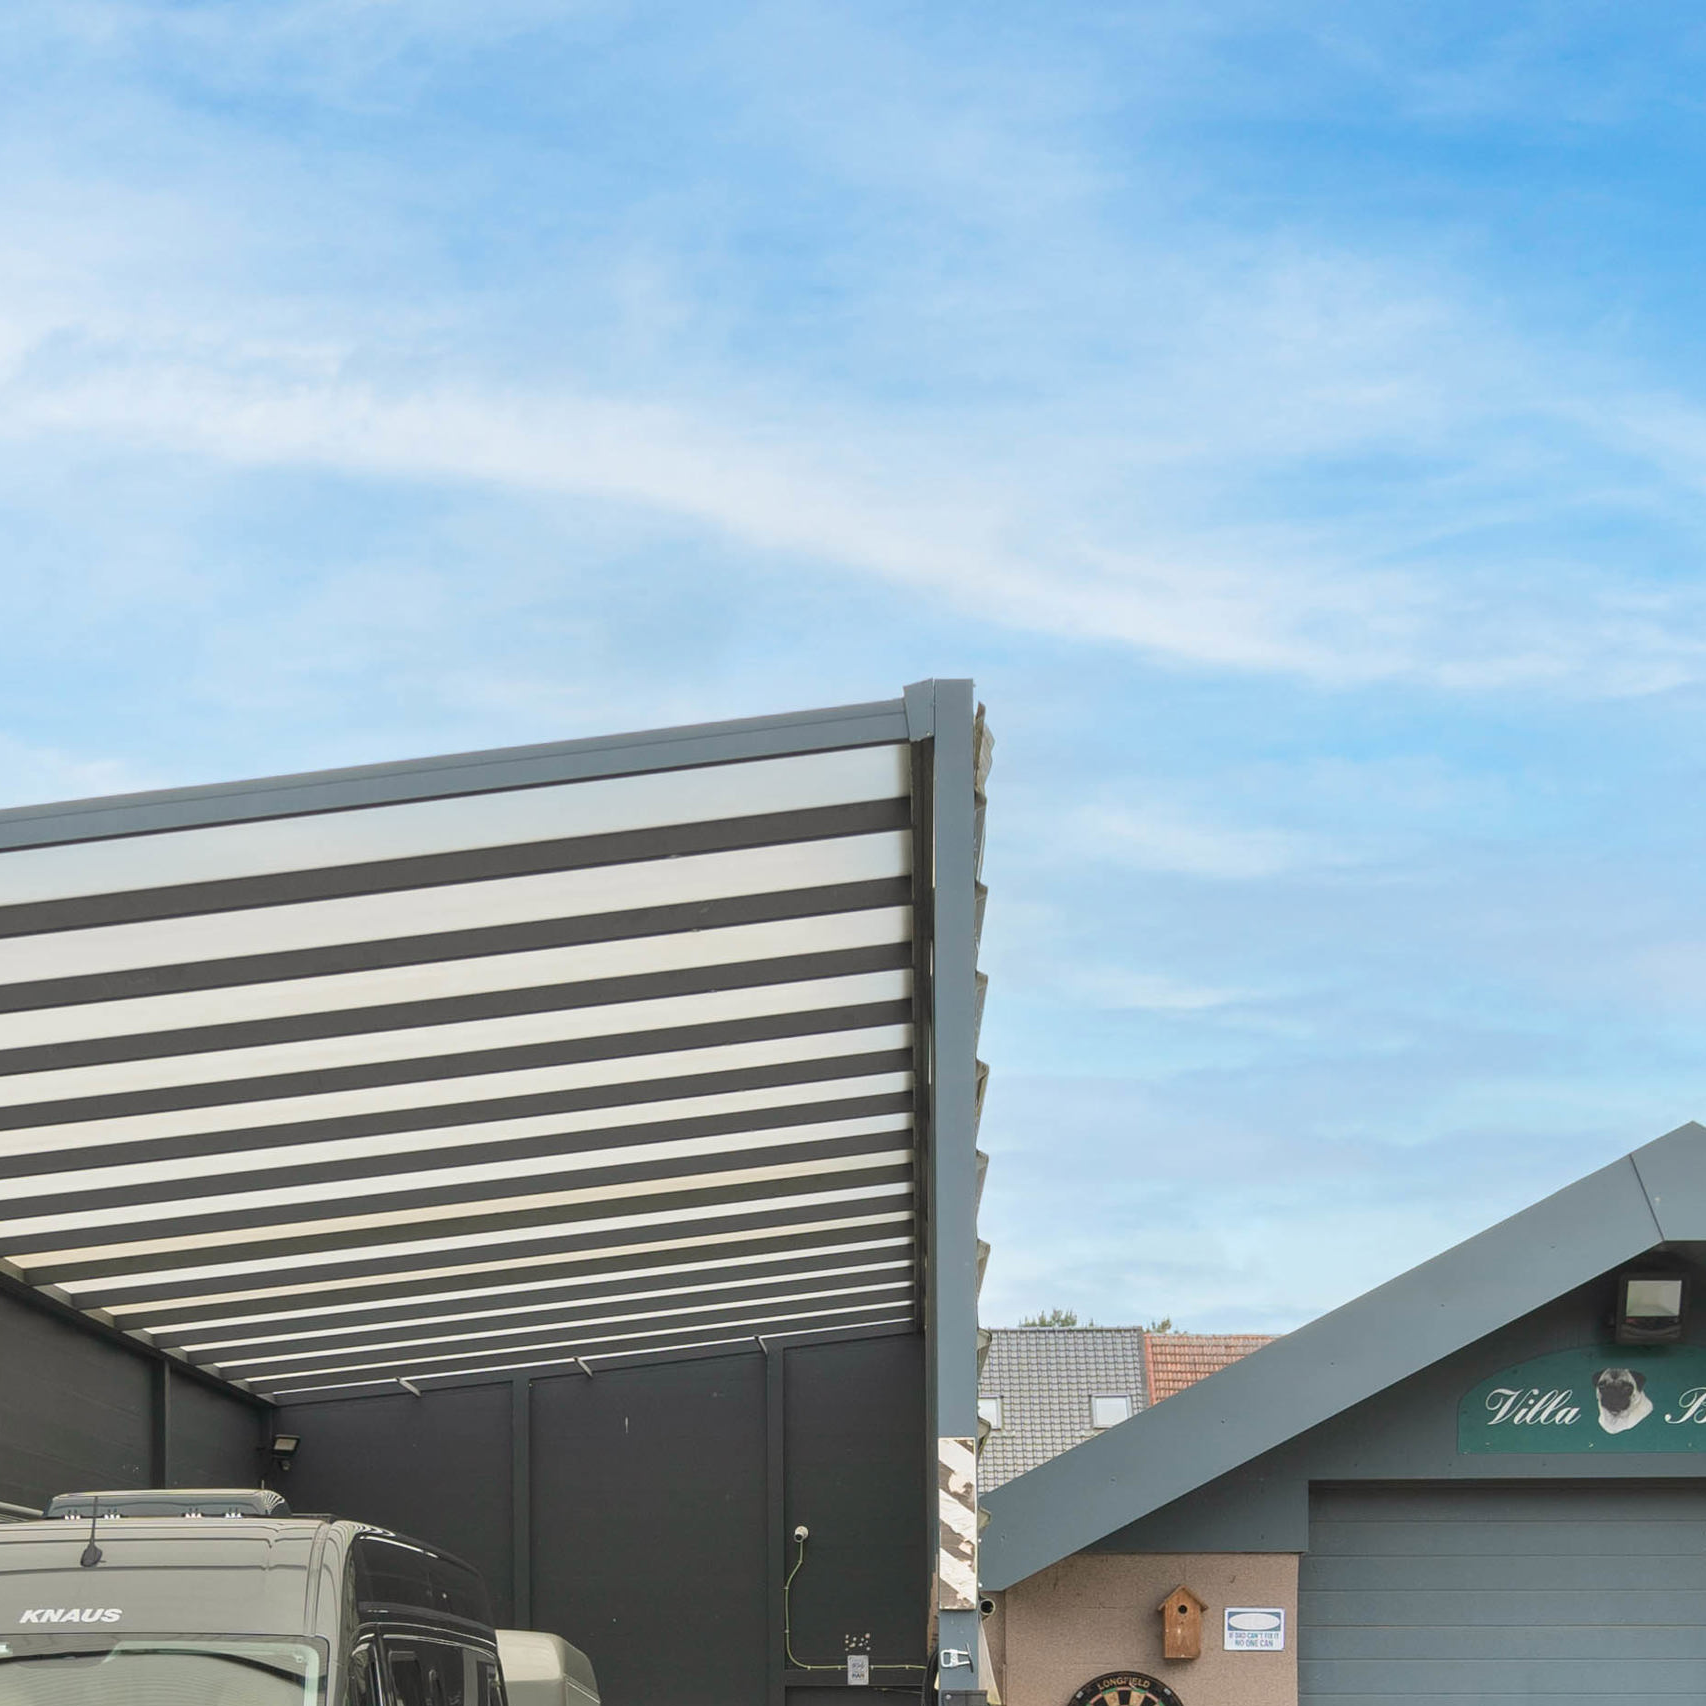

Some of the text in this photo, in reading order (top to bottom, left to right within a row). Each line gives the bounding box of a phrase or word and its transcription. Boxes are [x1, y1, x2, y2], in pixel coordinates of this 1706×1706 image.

[1485, 1387, 1582, 1425] Villa
[19, 1608, 123, 1624] KNAUS
[1097, 1677, 1150, 1690] LONGFIELD
